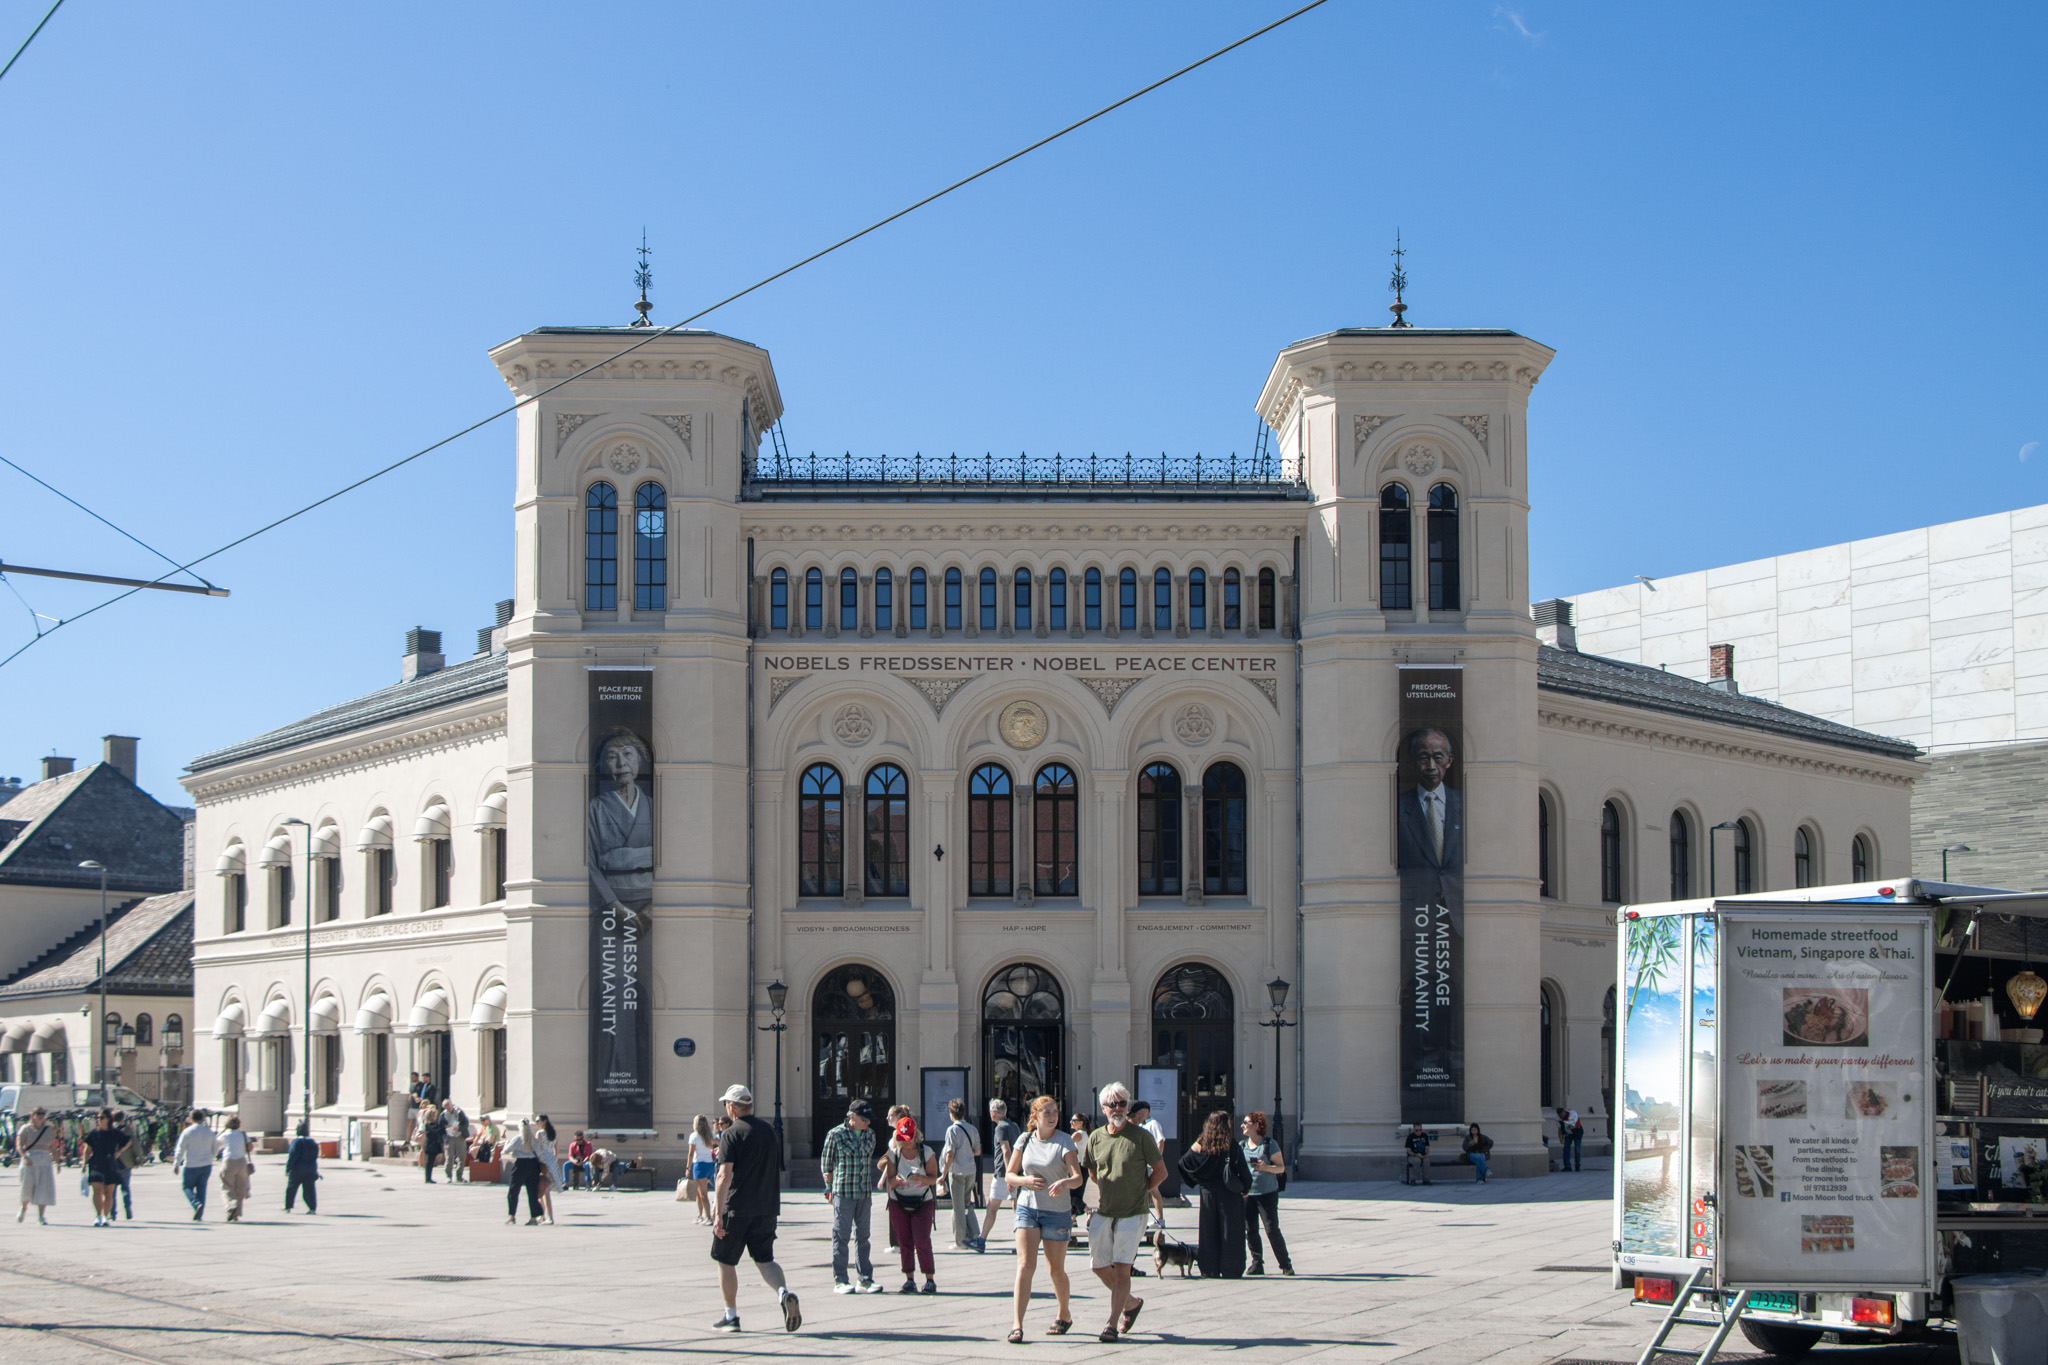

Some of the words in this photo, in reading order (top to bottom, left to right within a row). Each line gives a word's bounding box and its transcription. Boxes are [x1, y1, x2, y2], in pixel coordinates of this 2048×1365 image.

[764, 656, 850, 670] NOBELS
[860, 657, 1014, 671] FREDSSENTER
[1033, 657, 1106, 671] NOBEL
[1115, 657, 1186, 671] PEACE
[1191, 657, 1277, 671] CENTER
[602, 907, 616, 931] TO
[623, 907, 637, 922] A
[1415, 904, 1429, 928] TO
[1435, 904, 1450, 918] A
[356, 926, 381, 939] NOBEL
[383, 923, 409, 935] PEACE
[411, 920, 443, 933] CENTER
[1752, 928, 1827, 940] Homemade
[1831, 929, 1898, 941] streetfood
[271, 936, 297, 948] NOBELS
[300, 930, 348, 944] FRDSSENTER
[1737, 946, 1797, 960] Vietnam,
[1800, 946, 1865, 961] Singapore
[1869, 947, 1879, 959] &
[1883, 947, 1915, 959] Thai.
[623, 925, 637, 1010] MESSAGE
[1435, 922, 1450, 1006] MESSAGE
[1415, 933, 1429, 1032] HUMANITY
[1742, 969, 1779, 979] Noodles
[1780, 971, 1796, 979] and
[1846, 971, 1856, 981] of
[602, 936, 616, 1036] HUMANITY
[1736, 1052, 1767, 1065] Let's
[1769, 1057, 1782, 1065] us
[1784, 1053, 1813, 1065] make
[1814, 1057, 1840, 1069] your
[1840, 1057, 1869, 1069] party
[1870, 1054, 1915, 1069] different
[1797, 1147, 1824, 1155] parties,
[1756, 1292, 1793, 1309] 73225
